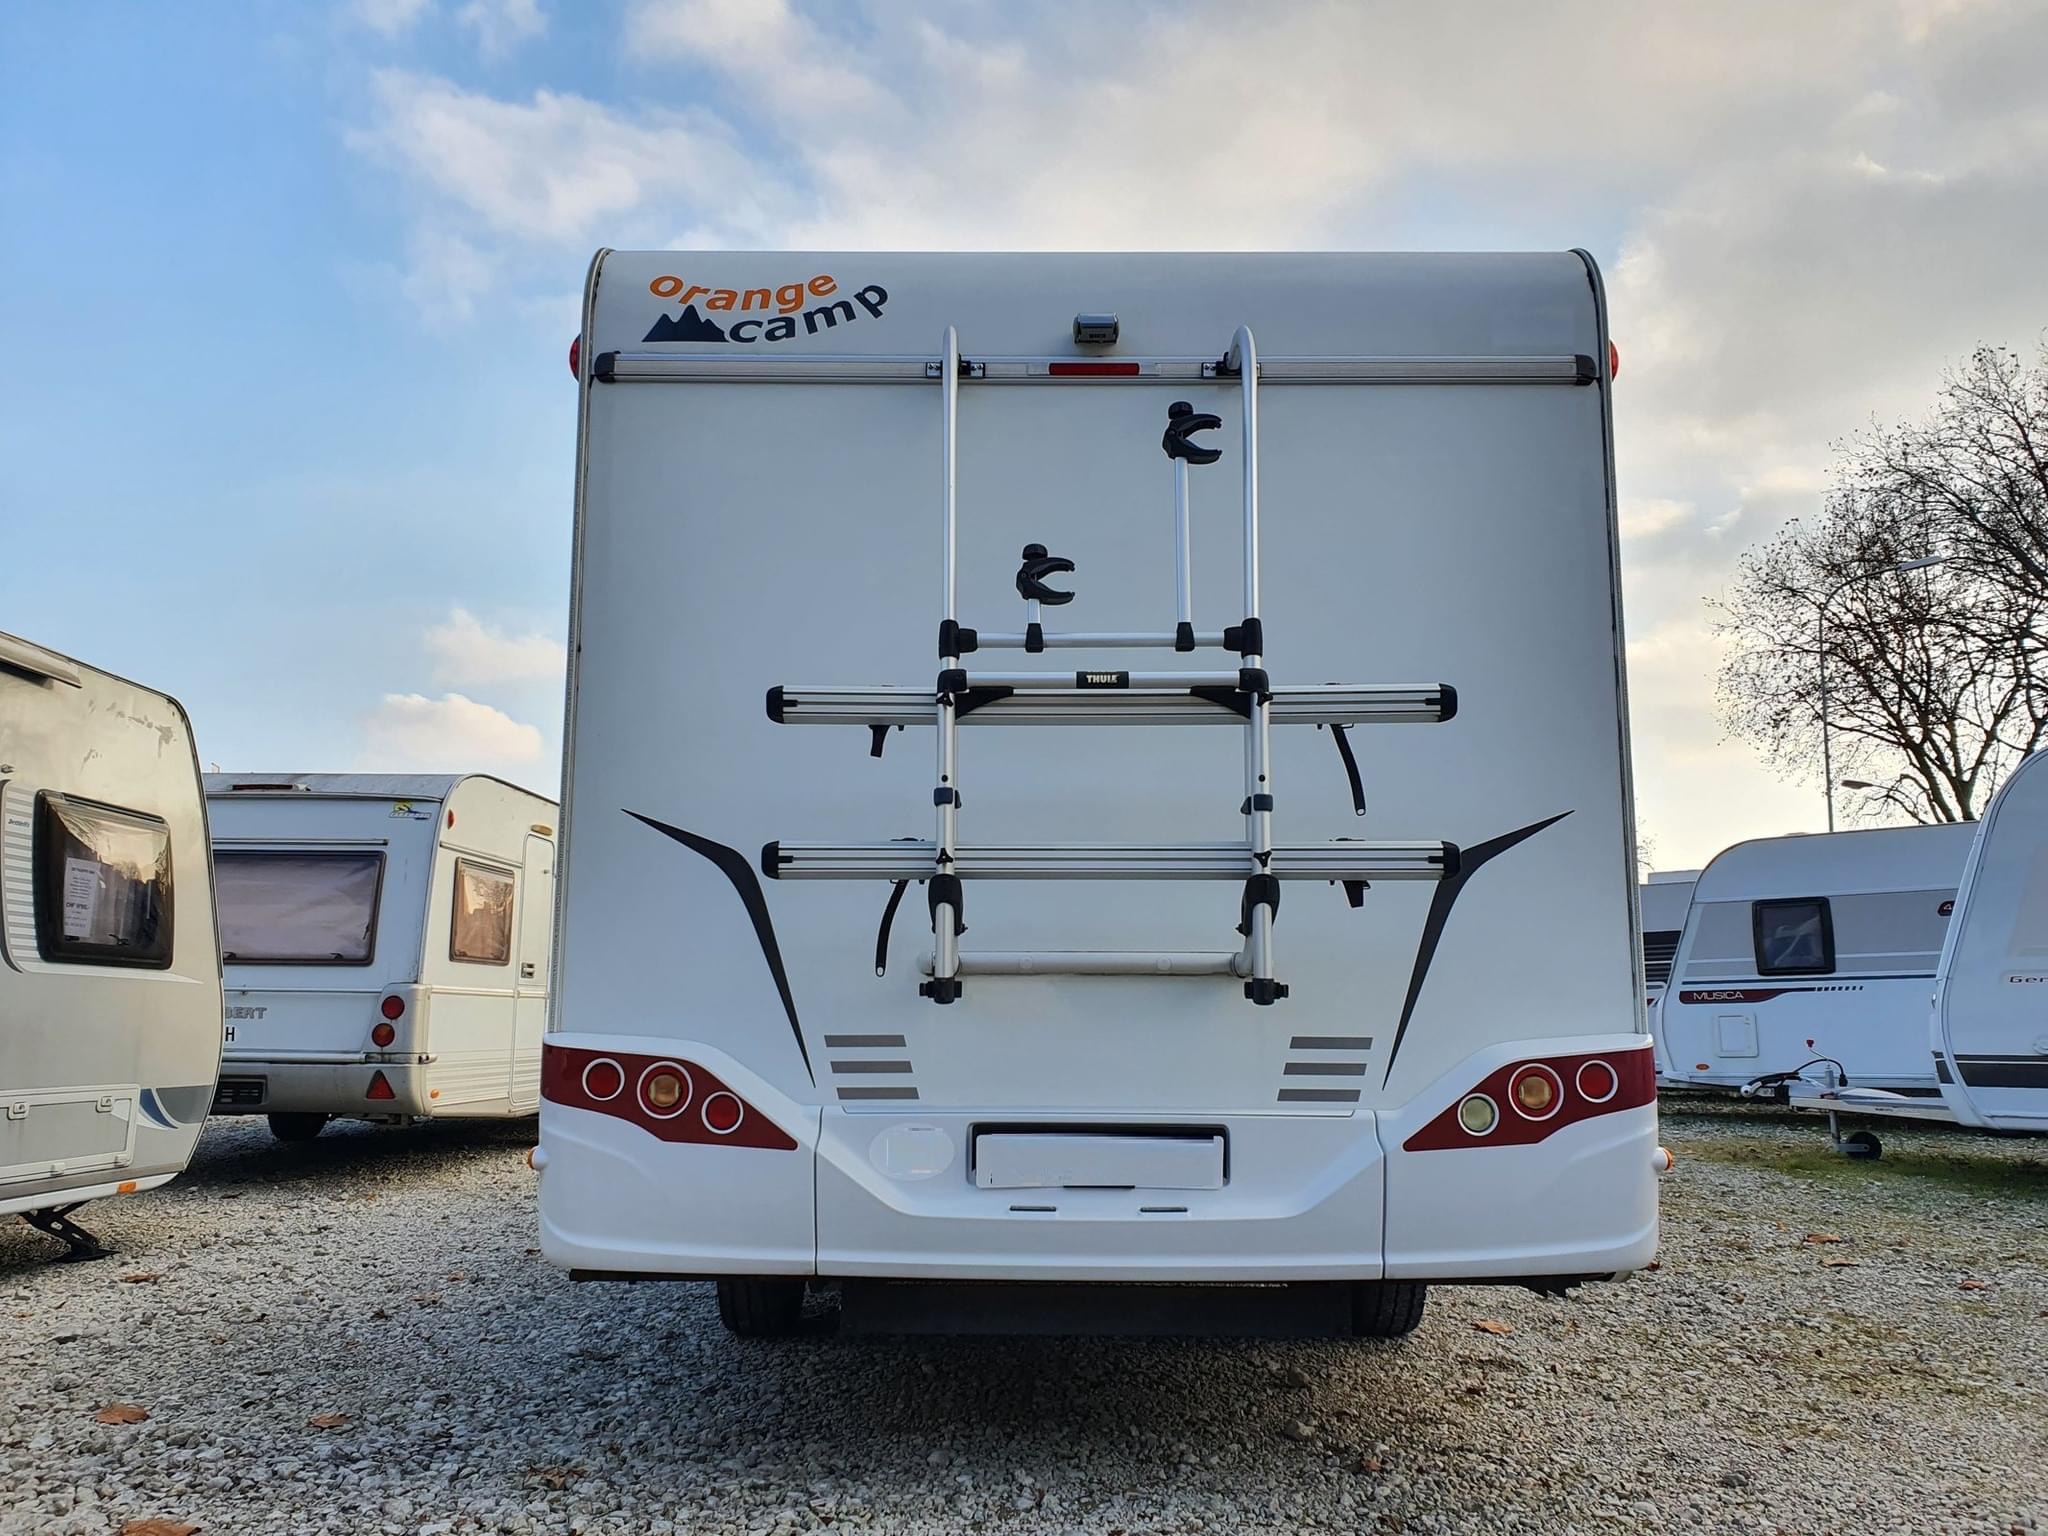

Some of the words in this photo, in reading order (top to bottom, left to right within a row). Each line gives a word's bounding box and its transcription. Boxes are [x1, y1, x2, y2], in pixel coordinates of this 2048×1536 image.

[650, 274, 838, 315] orange
[728, 285, 888, 343] camp
[1086, 674, 1119, 684] THULE
[1693, 991, 1744, 1000] MUSICA
